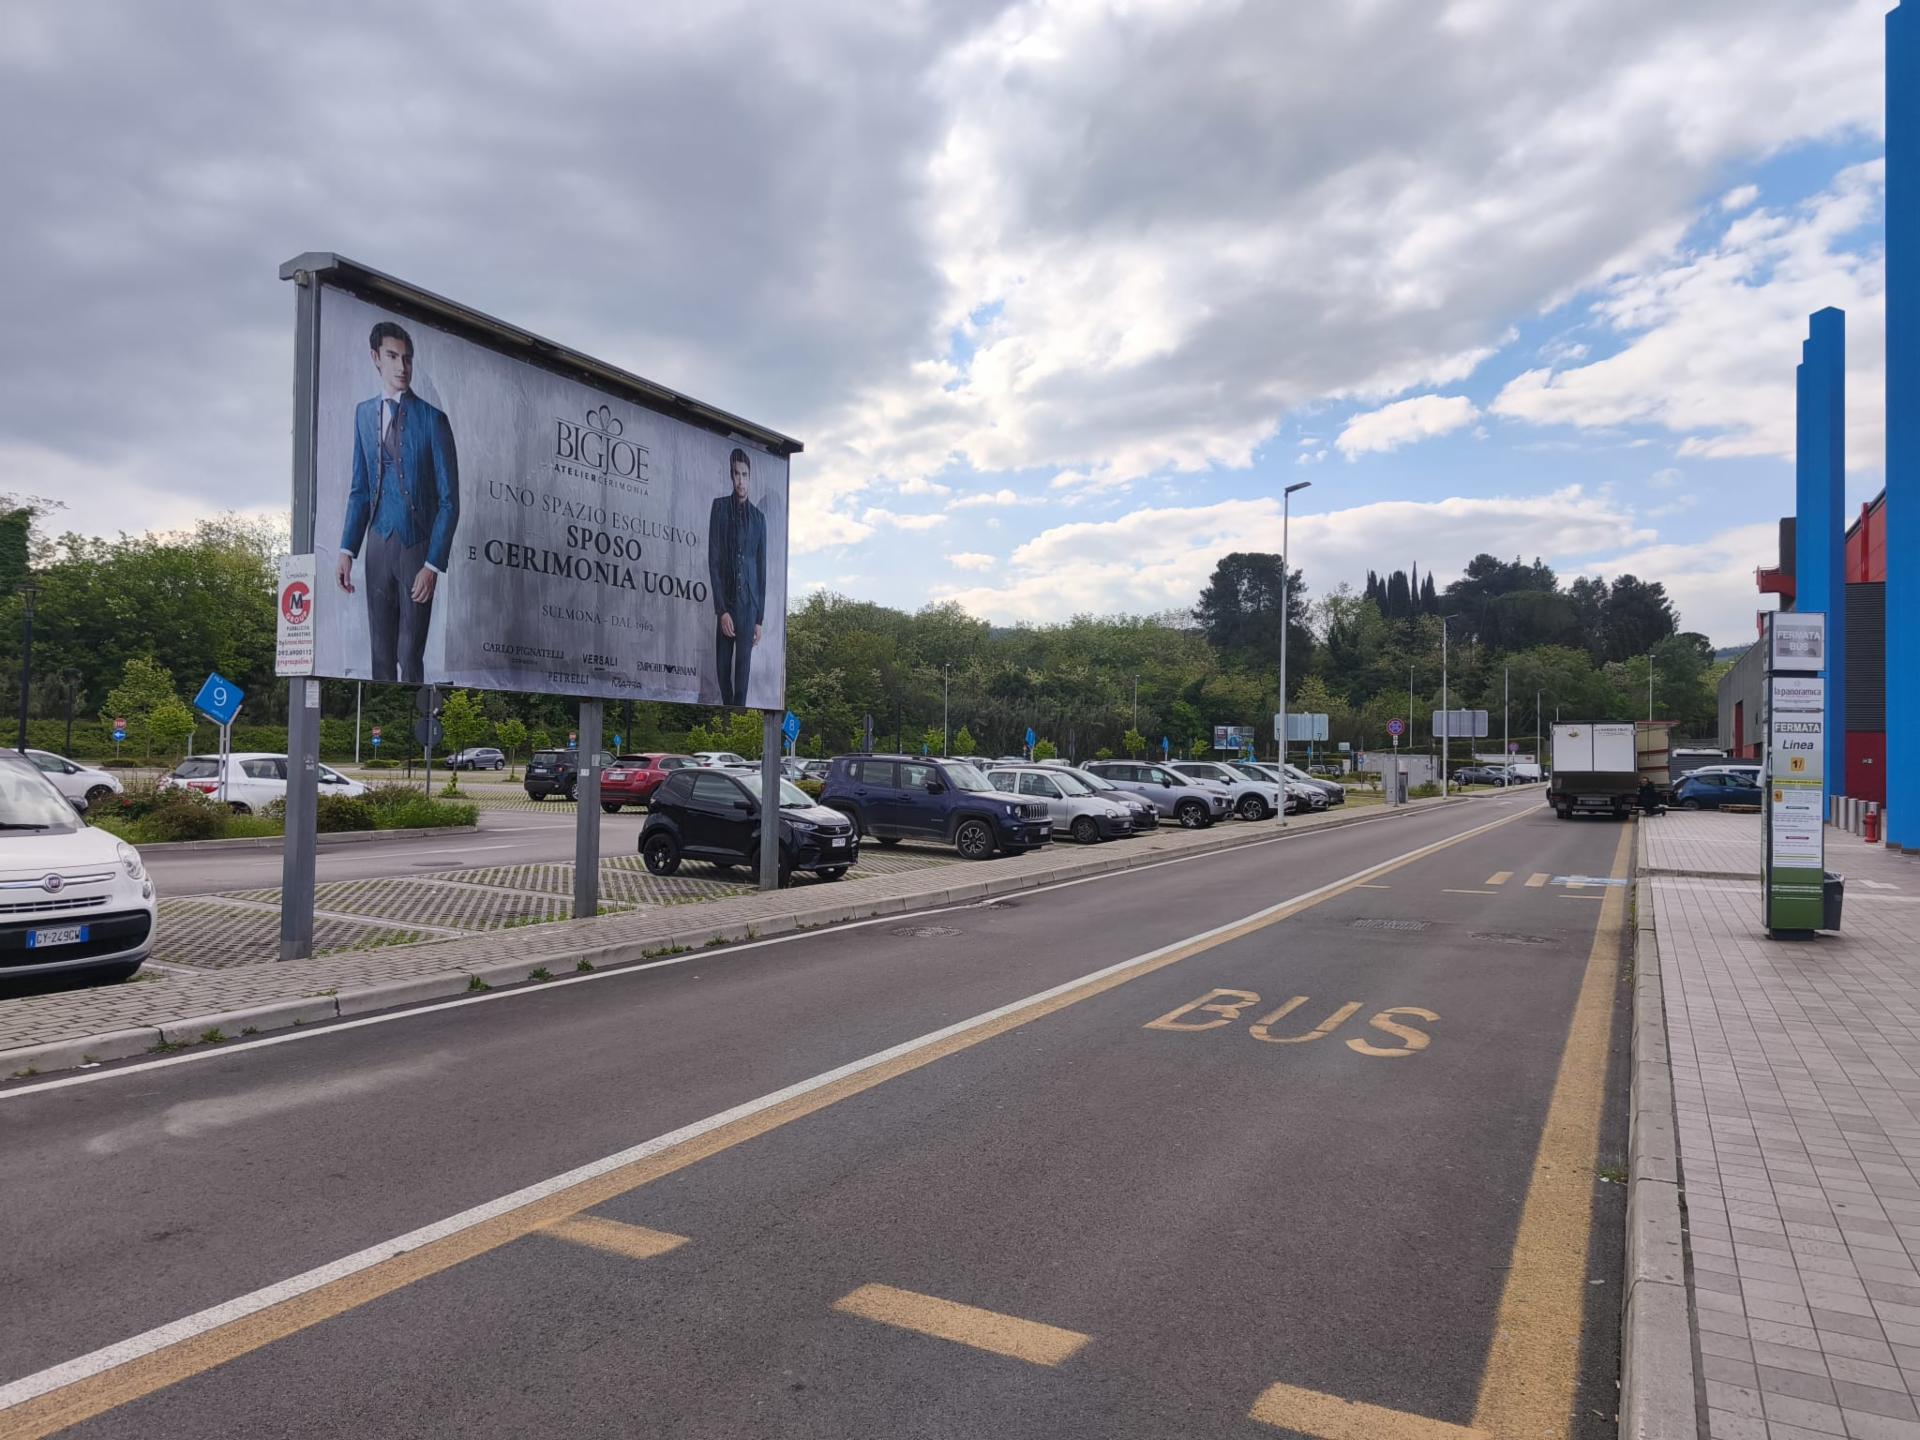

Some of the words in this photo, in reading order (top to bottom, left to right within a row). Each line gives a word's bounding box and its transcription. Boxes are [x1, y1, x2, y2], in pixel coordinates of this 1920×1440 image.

[488, 480, 535, 508] UNO
[542, 494, 606, 525] SPAZIO
[612, 511, 698, 548] ESCLUSIVO
[567, 524, 642, 561] SPOSO
[468, 546, 477, 560] E
[484, 539, 637, 590] CERIMONIA
[643, 570, 707, 602] UOMO
[542, 604, 601, 625] SULMONA
[611, 615, 632, 629] DAL
[1776, 630, 1821, 641] FERMATA
[482, 642, 514, 654] CARLO
[516, 645, 565, 659] PIGNATELLI
[1789, 642, 1809, 651] BUS
[582, 653, 618, 667] VERSALI
[548, 671, 590, 684] PETRELLI
[213, 687, 227, 706] 9
[1774, 723, 1821, 733] FERMATA
[1782, 739, 1814, 750] Linea
[1142, 988, 1441, 1057] BUS
